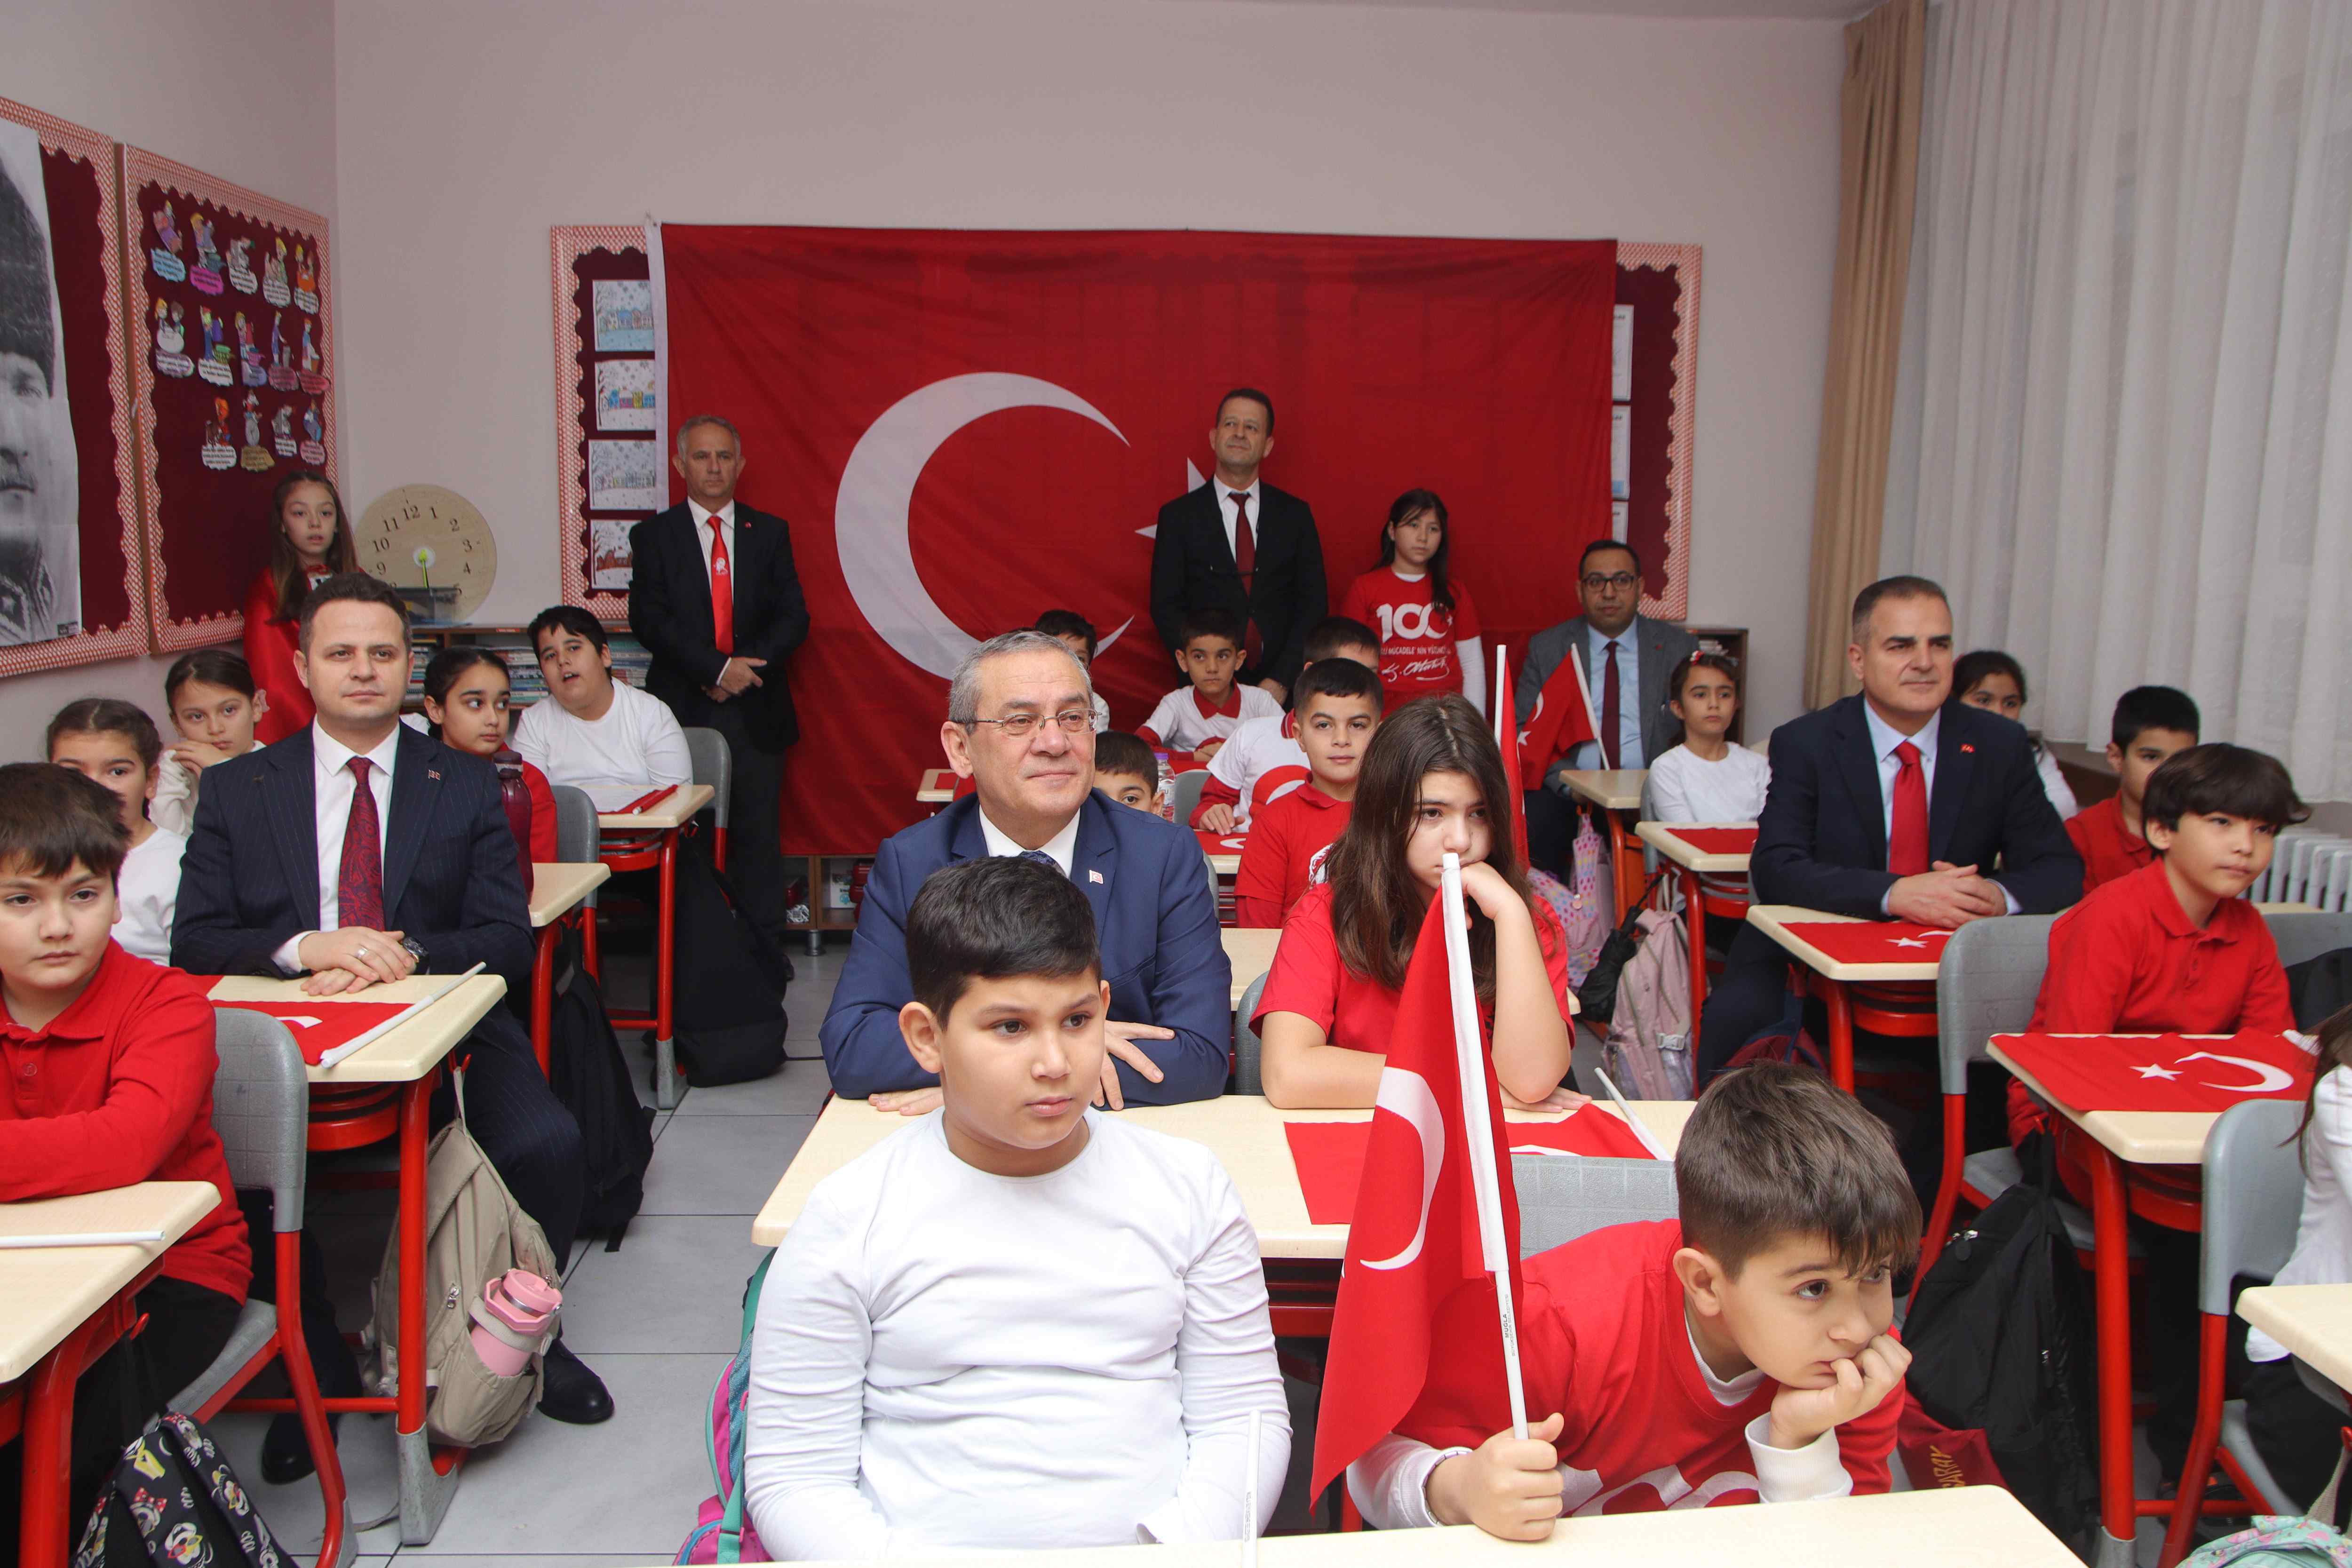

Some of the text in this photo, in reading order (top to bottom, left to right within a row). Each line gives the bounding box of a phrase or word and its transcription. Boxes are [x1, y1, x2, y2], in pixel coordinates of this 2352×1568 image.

[403, 505, 421, 520] 12
[429, 506, 438, 519] 1
[383, 517, 399, 533] 11
[450, 518, 460, 532] 2
[373, 537, 390, 552] 10
[463, 539, 472, 553] 3
[376, 561, 386, 575] 9
[463, 561, 471, 574] 4
